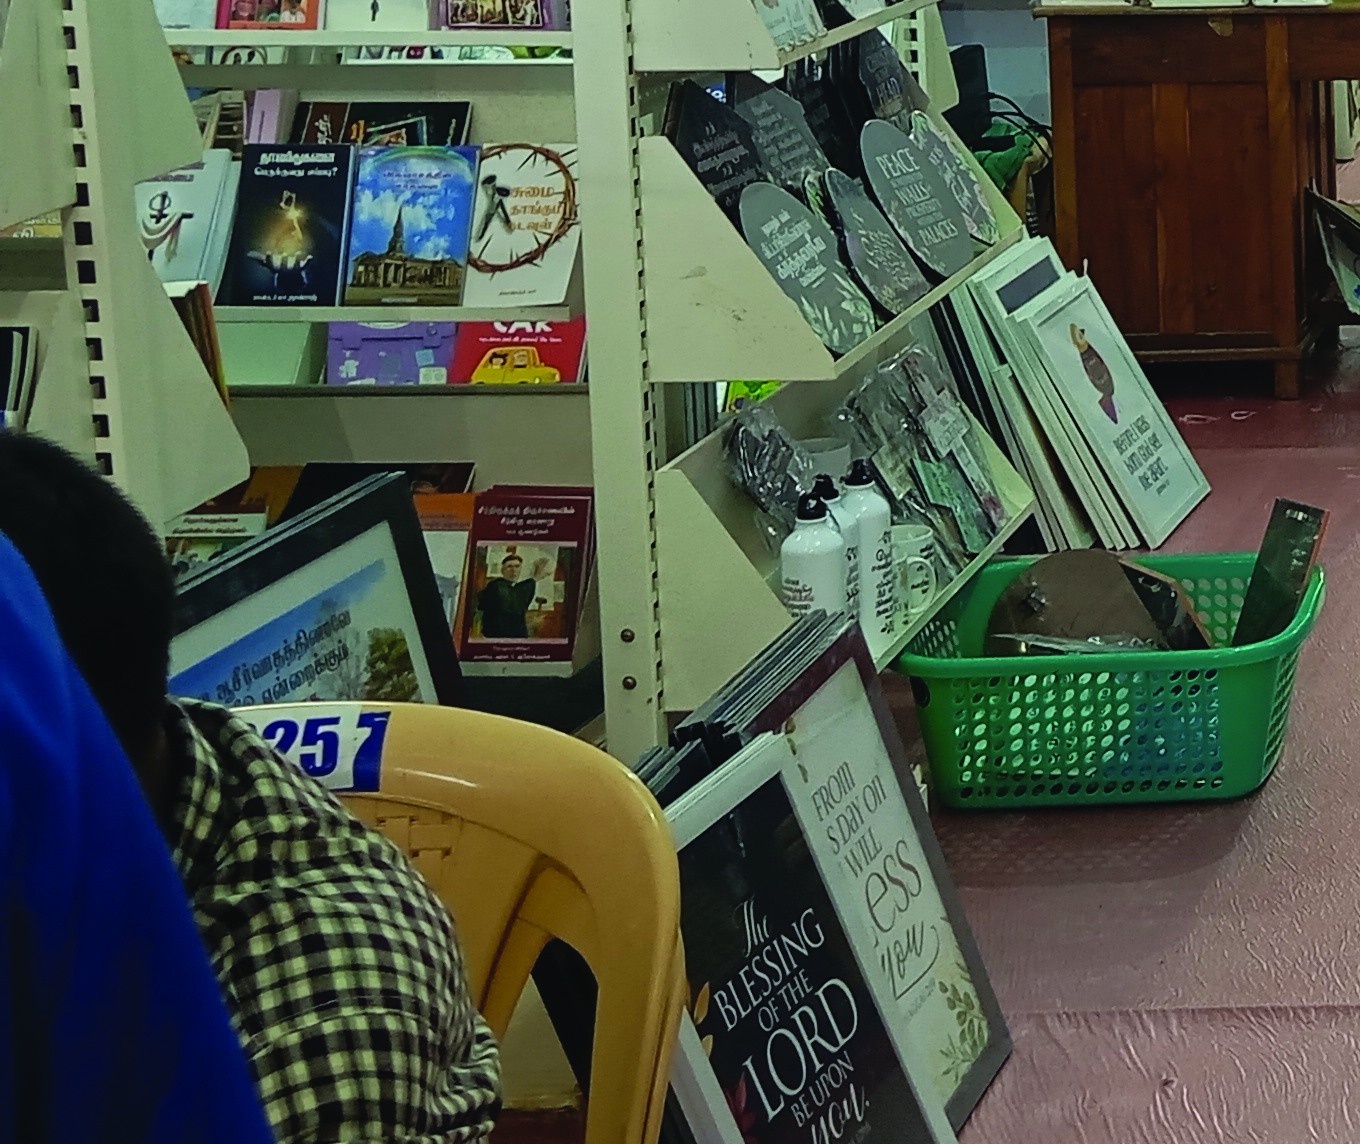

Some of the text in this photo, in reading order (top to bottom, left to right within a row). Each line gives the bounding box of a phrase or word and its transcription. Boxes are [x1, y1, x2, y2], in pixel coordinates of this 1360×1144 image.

[875, 147, 921, 180] PEACE
[262, 716, 341, 777] 25
[811, 760, 856, 823] FROM
[713, 907, 826, 1032] BLESSING
[757, 968, 814, 1033] OF THE
[741, 977, 860, 1122] LORD
[791, 1050, 855, 1128] BE UPON
